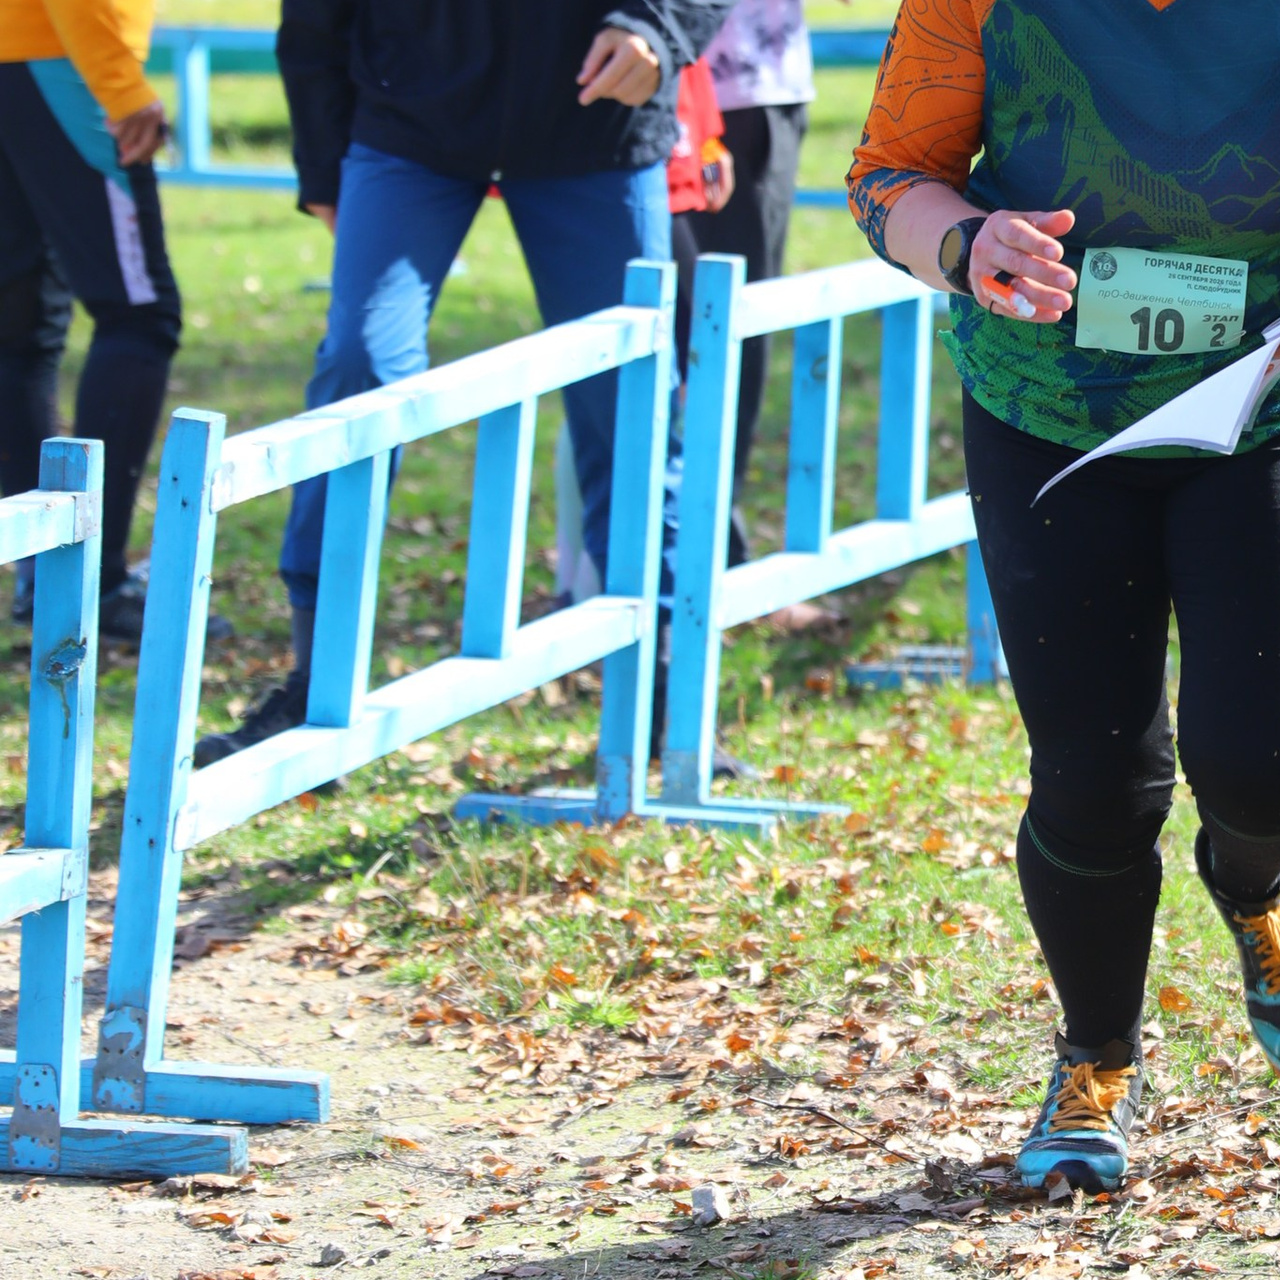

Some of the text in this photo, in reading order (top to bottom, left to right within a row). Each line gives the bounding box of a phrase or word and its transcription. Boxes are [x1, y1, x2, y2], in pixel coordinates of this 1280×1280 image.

[1144, 257, 1244, 277] ГОРЯЧАЯ ДЕСЯТКА
[1177, 274, 1208, 283] СЕНТЯБРЯ
[1098, 289, 1232, 310] прО-движение Челябинск
[1202, 314, 1240, 322] ЭТАП
[1130, 306, 1185, 352] 10
[1210, 323, 1226, 347] 2
